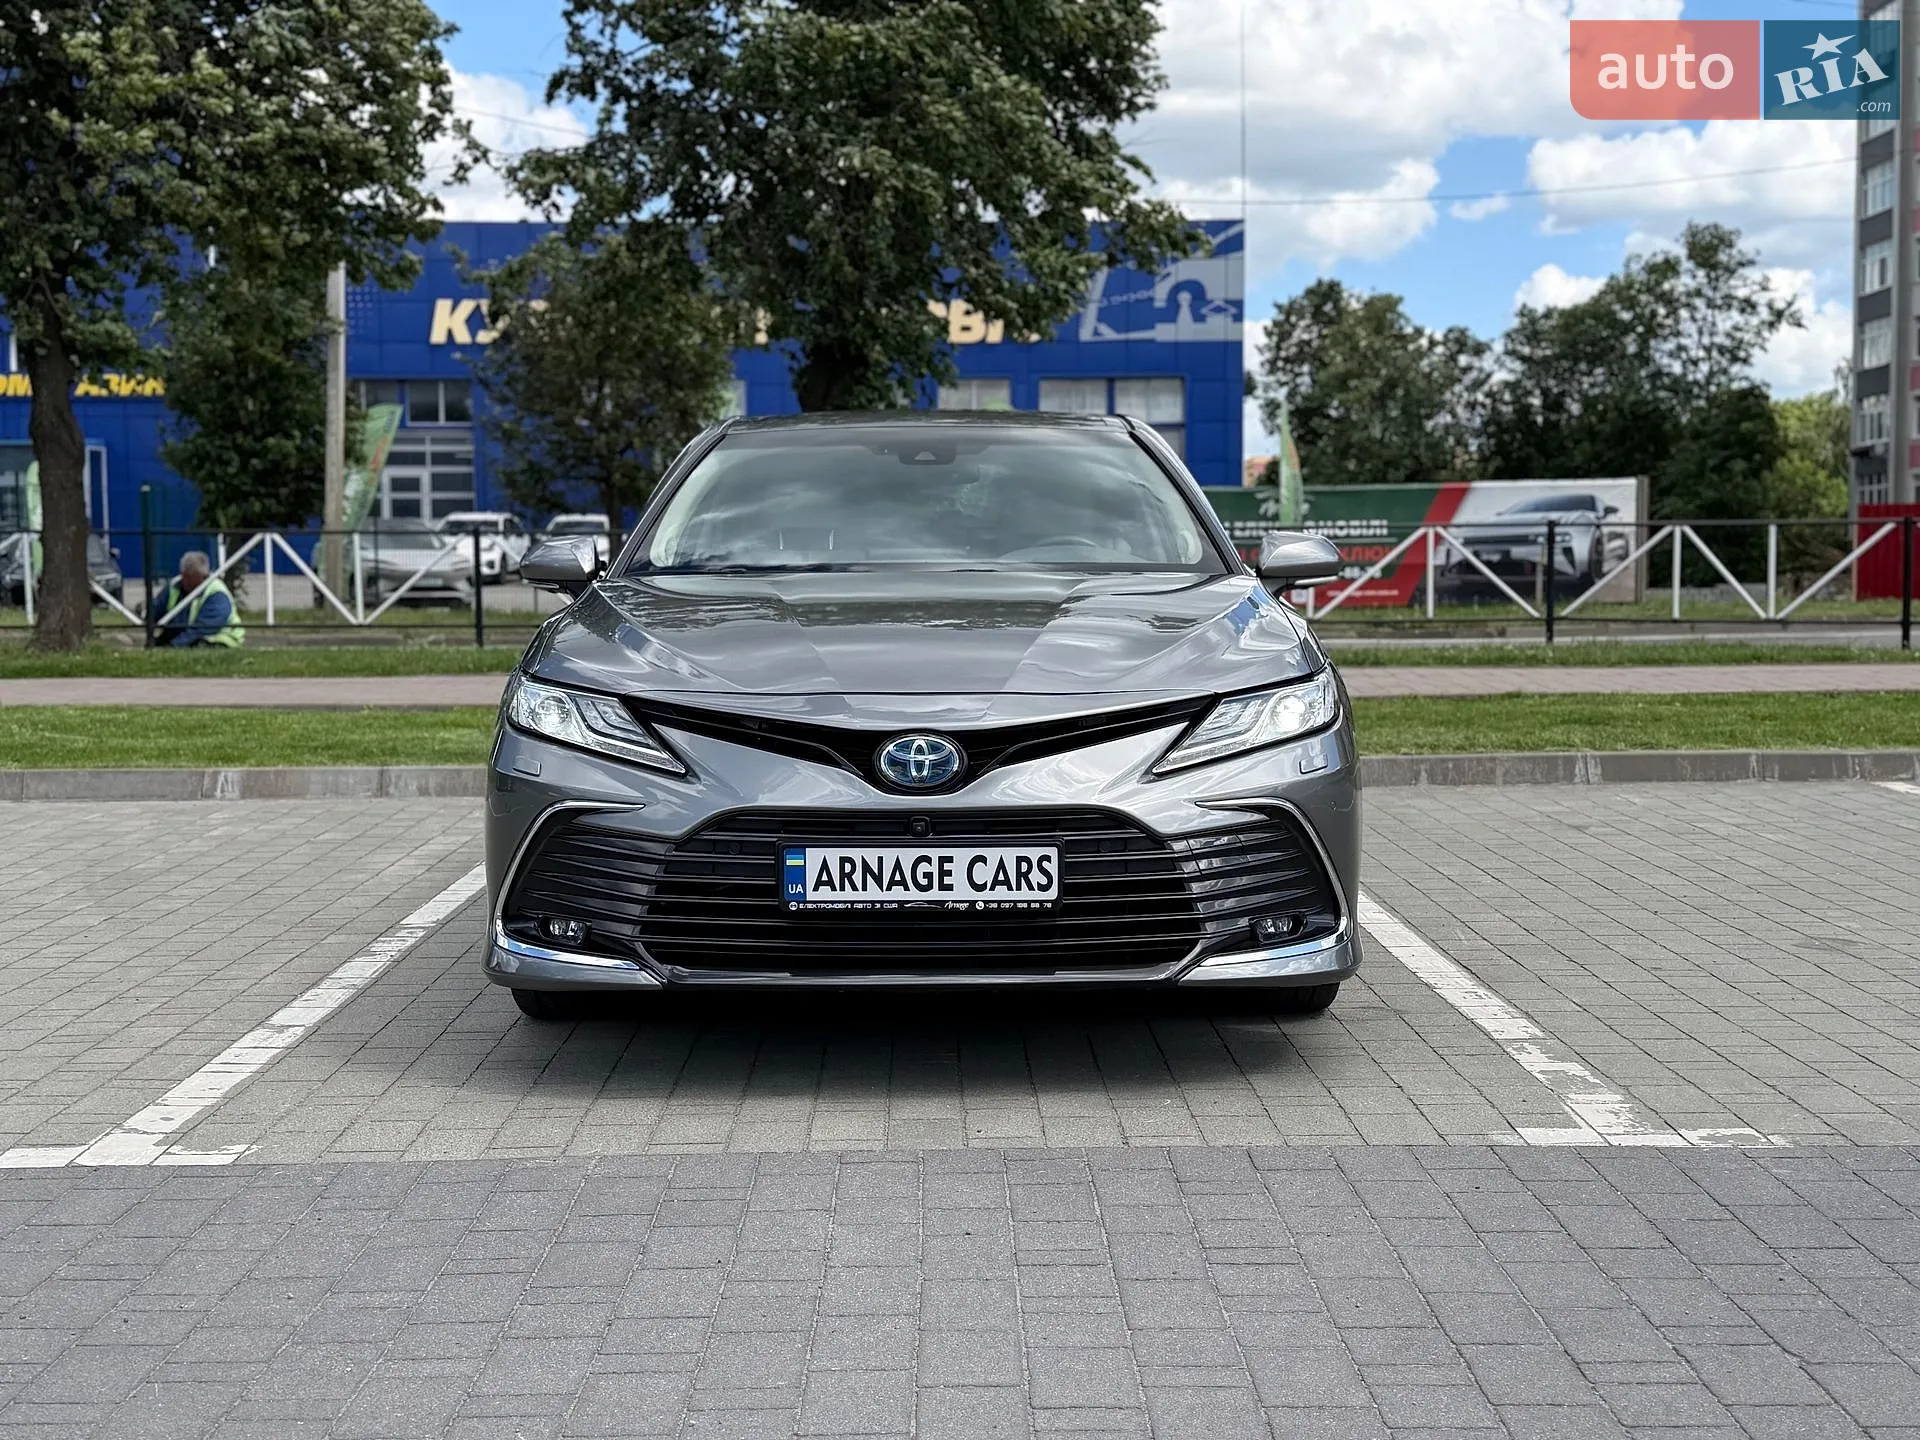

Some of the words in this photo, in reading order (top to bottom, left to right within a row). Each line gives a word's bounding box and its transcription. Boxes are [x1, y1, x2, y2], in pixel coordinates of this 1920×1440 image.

[812, 854, 955, 893] ARNAGE
[966, 854, 1054, 893] CARS
[788, 883, 804, 894] UA
